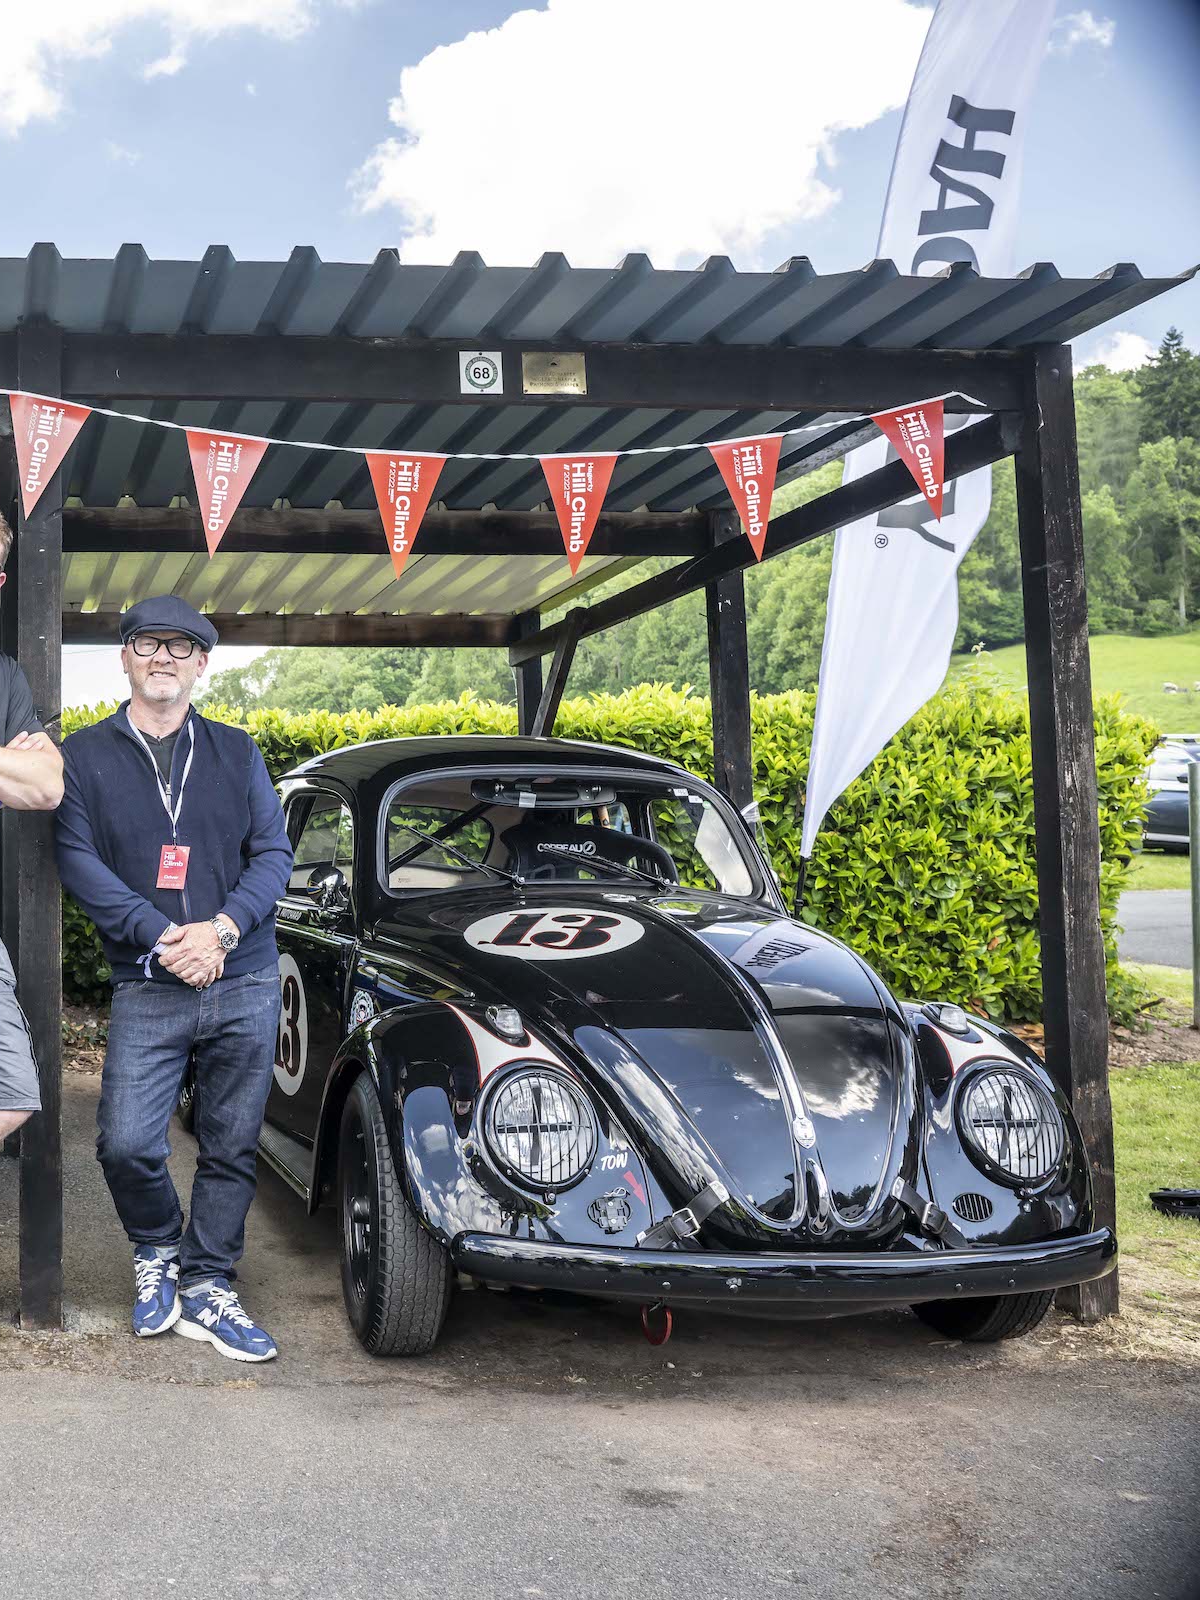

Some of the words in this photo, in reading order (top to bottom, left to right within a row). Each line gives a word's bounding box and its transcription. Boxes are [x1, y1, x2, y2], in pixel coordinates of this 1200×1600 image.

[473, 367, 490, 379] 68
[37, 405, 56, 436] Hill
[53, 408, 65, 437] Hagerty
[918, 410, 931, 438] Hagerty
[25, 438, 49, 492] Climb
[216, 441, 234, 472] Hill
[232, 444, 242, 473] Hagerty
[740, 446, 757, 477] Hill
[755, 445, 763, 474] Hagerty
[903, 412, 925, 442] Hill
[916, 443, 940, 498] Climb
[397, 461, 412, 492] Hill
[412, 462, 421, 492] Hagerty
[572, 462, 586, 493] Hill
[208, 475, 228, 531] Climb
[744, 480, 763, 536] Climb
[393, 495, 410, 553] Climb
[569, 496, 586, 553] Climb
[477, 912, 621, 950] 13
[601, 1152, 628, 1171] TOW
